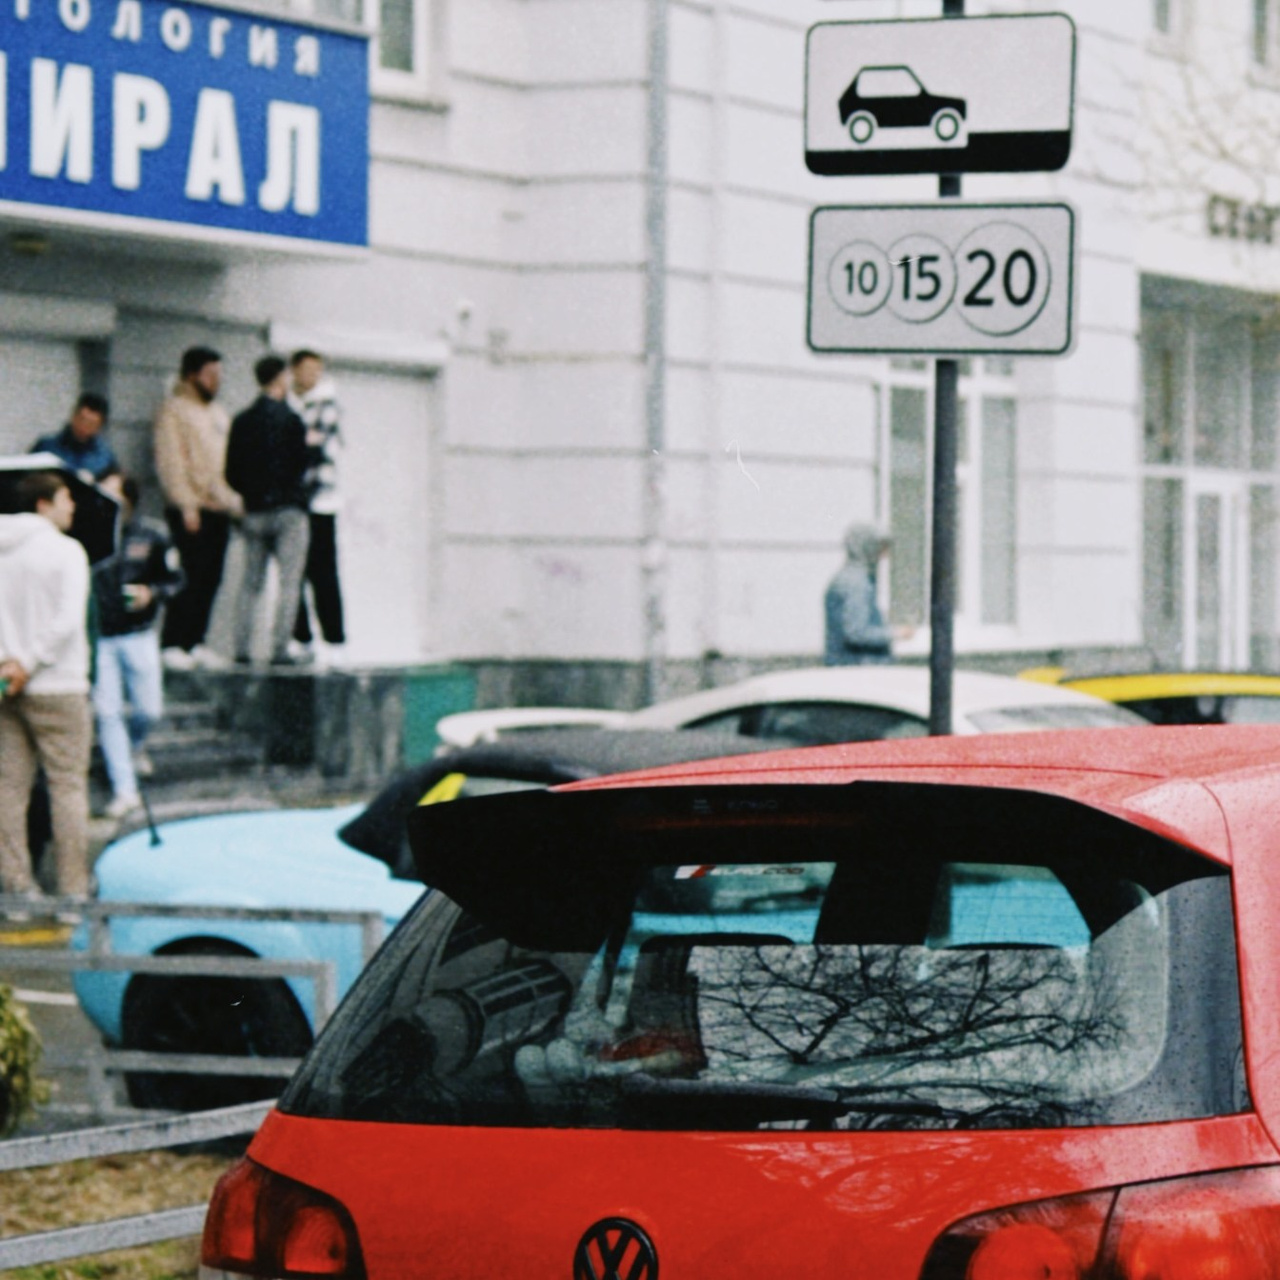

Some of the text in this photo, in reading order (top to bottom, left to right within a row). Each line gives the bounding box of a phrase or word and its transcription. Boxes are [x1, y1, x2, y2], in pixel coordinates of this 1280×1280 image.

[0, 49, 320, 217] ИРАЛ
[843, 248, 1038, 308] 10 15 20
